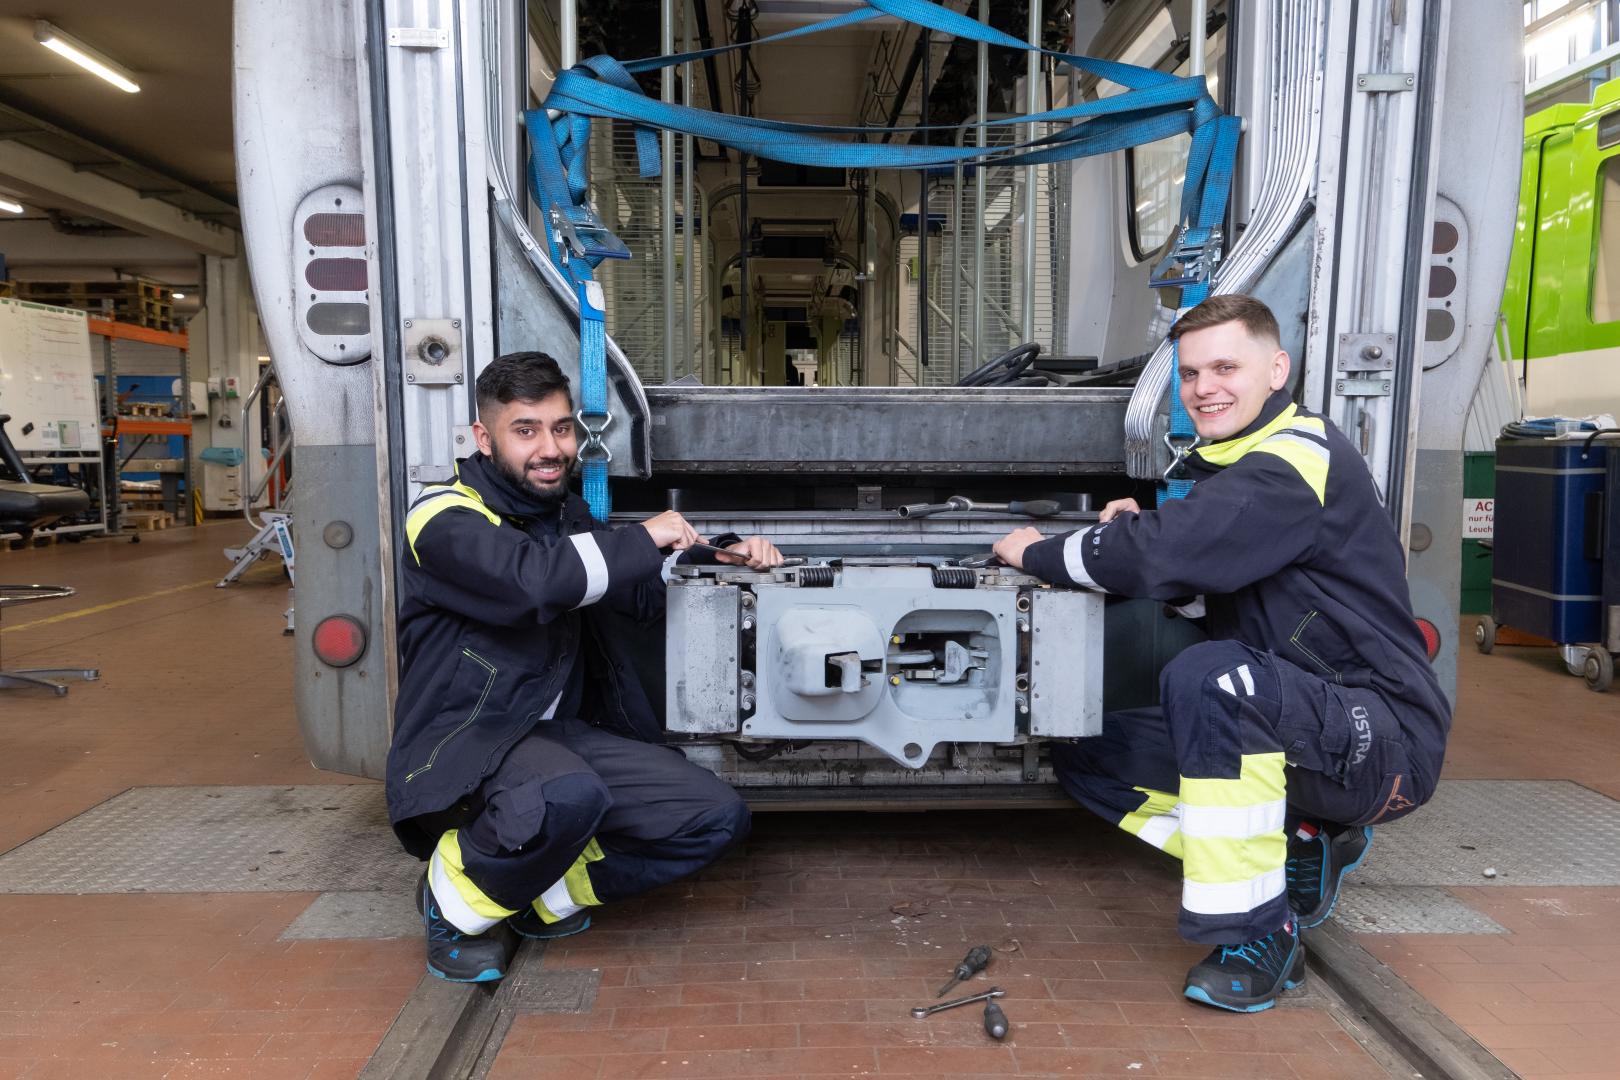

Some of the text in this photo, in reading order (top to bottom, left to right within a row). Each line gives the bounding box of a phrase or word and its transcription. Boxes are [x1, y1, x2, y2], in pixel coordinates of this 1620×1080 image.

[1475, 501, 1493, 512] AC
[1469, 525, 1493, 533] Leuch
[1352, 706, 1372, 764] ÜSTRA
